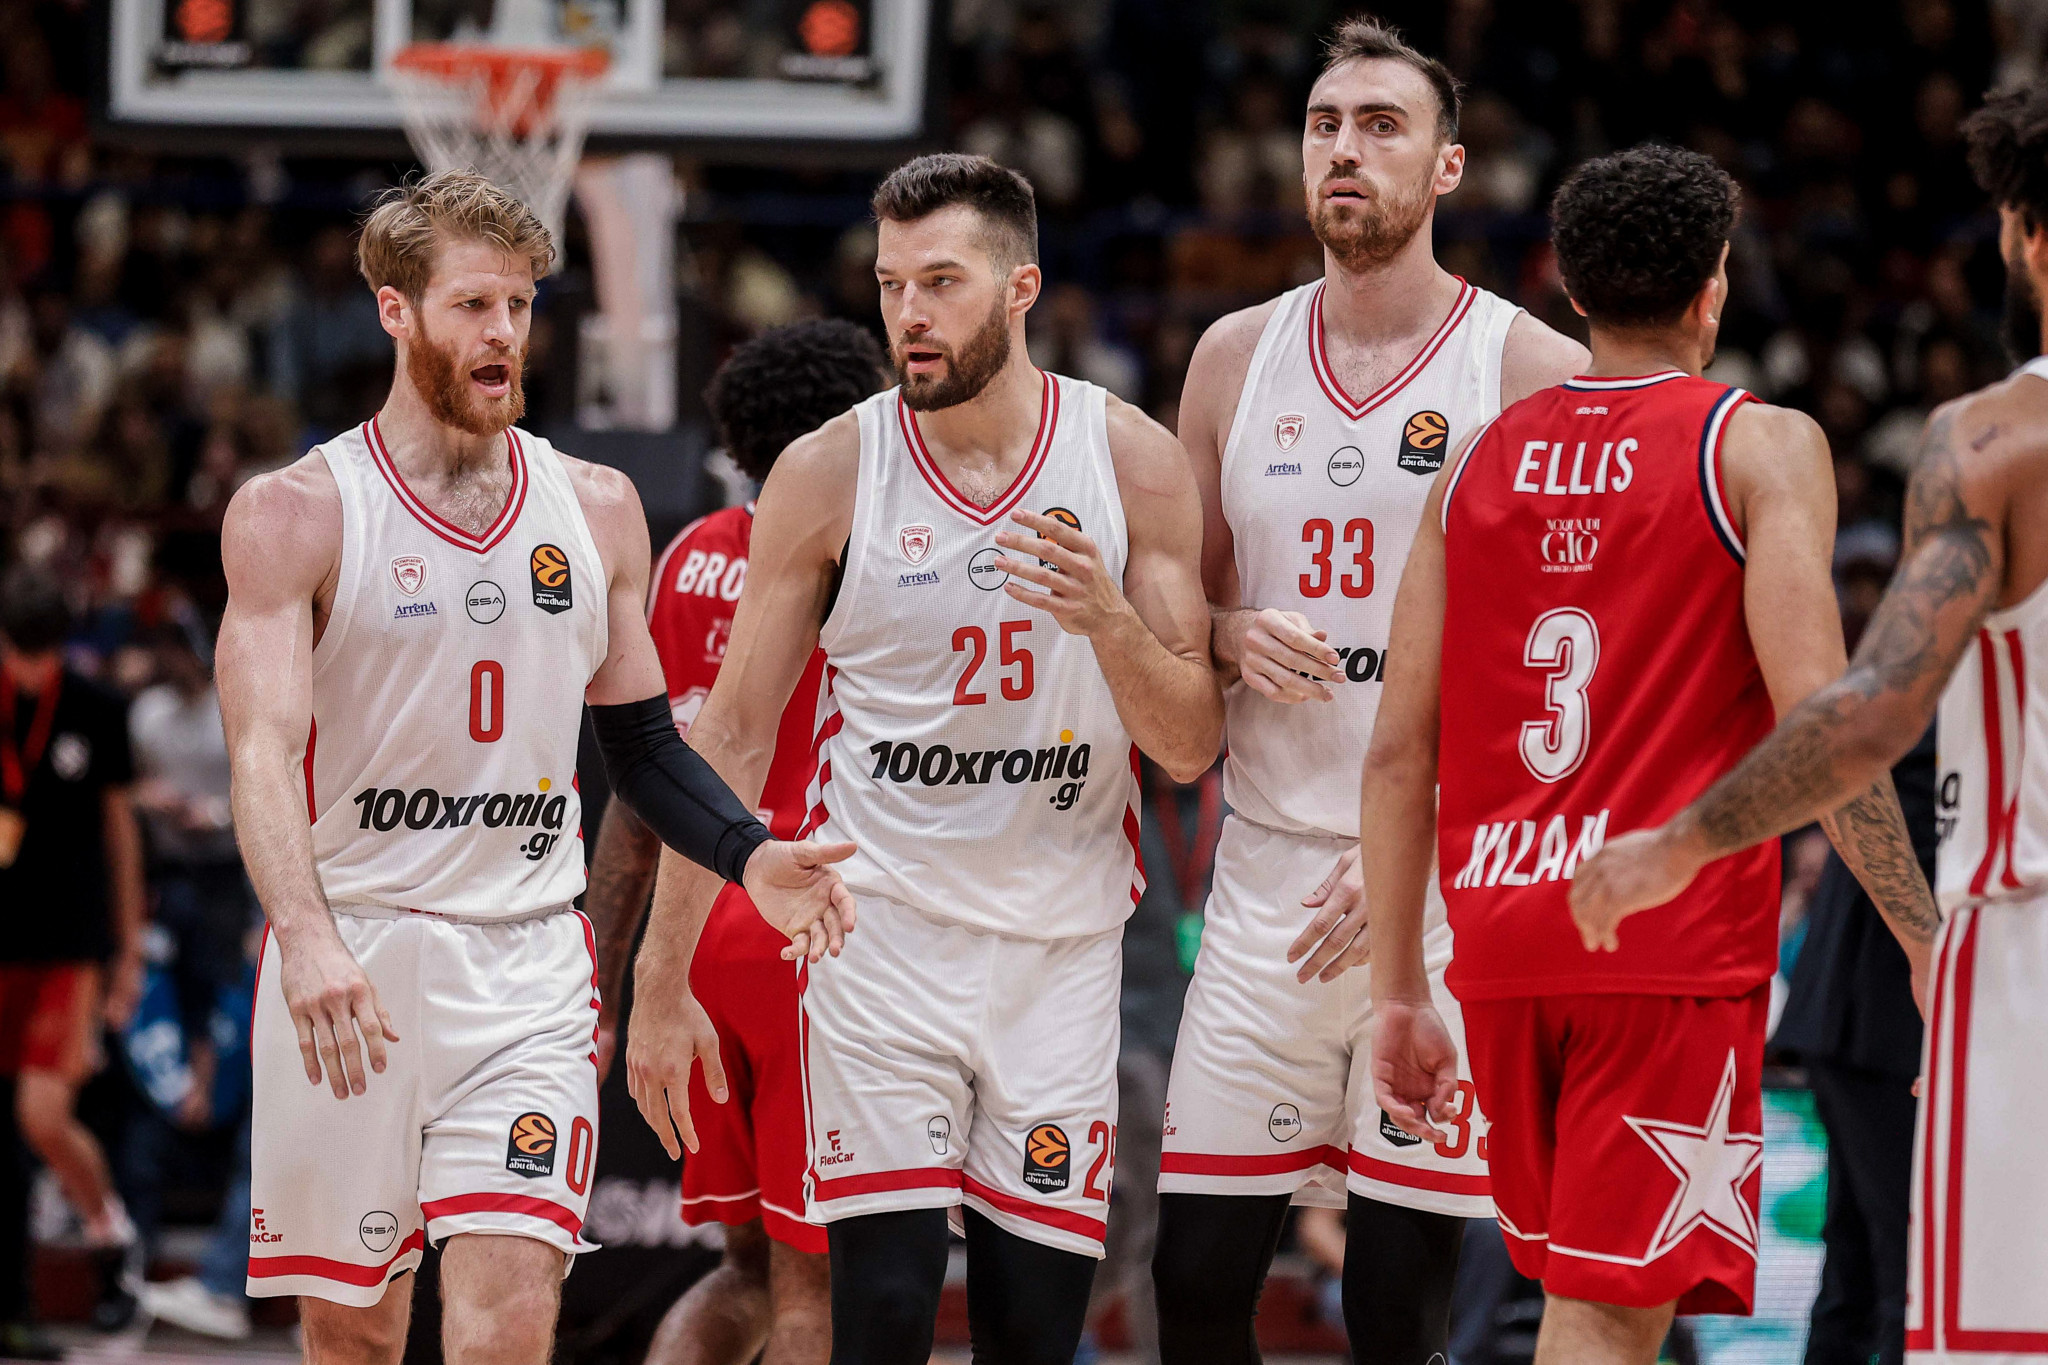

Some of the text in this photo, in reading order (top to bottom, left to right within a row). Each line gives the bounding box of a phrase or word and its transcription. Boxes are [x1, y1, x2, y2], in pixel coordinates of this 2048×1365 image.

[1331, 461, 1361, 469] GSA
[1417, 460, 1441, 468] dhabi
[1512, 437, 1639, 495] ELLIS
[1299, 518, 1374, 598] 33
[675, 549, 748, 601] BRO
[971, 565, 999, 574] GS
[468, 597, 503, 606] GSA
[536, 597, 570, 606] abu dhabi
[952, 620, 1034, 705] 25
[469, 660, 503, 743] 0
[1518, 606, 1600, 784] 3
[869, 729, 1091, 786] 100xronia
[353, 778, 567, 832] 100xronia
[1272, 1118, 1299, 1126] GSA
[1434, 1080, 1488, 1160] 3
[930, 1131, 947, 1139] GSA
[566, 1116, 593, 1196] 0
[820, 1152, 855, 1167] FlexCar
[509, 1161, 550, 1174] abu dhabi
[1025, 1176, 1066, 1187] abu dhabi
[363, 1226, 395, 1234] GSA
[250, 1232, 283, 1243] exCar
